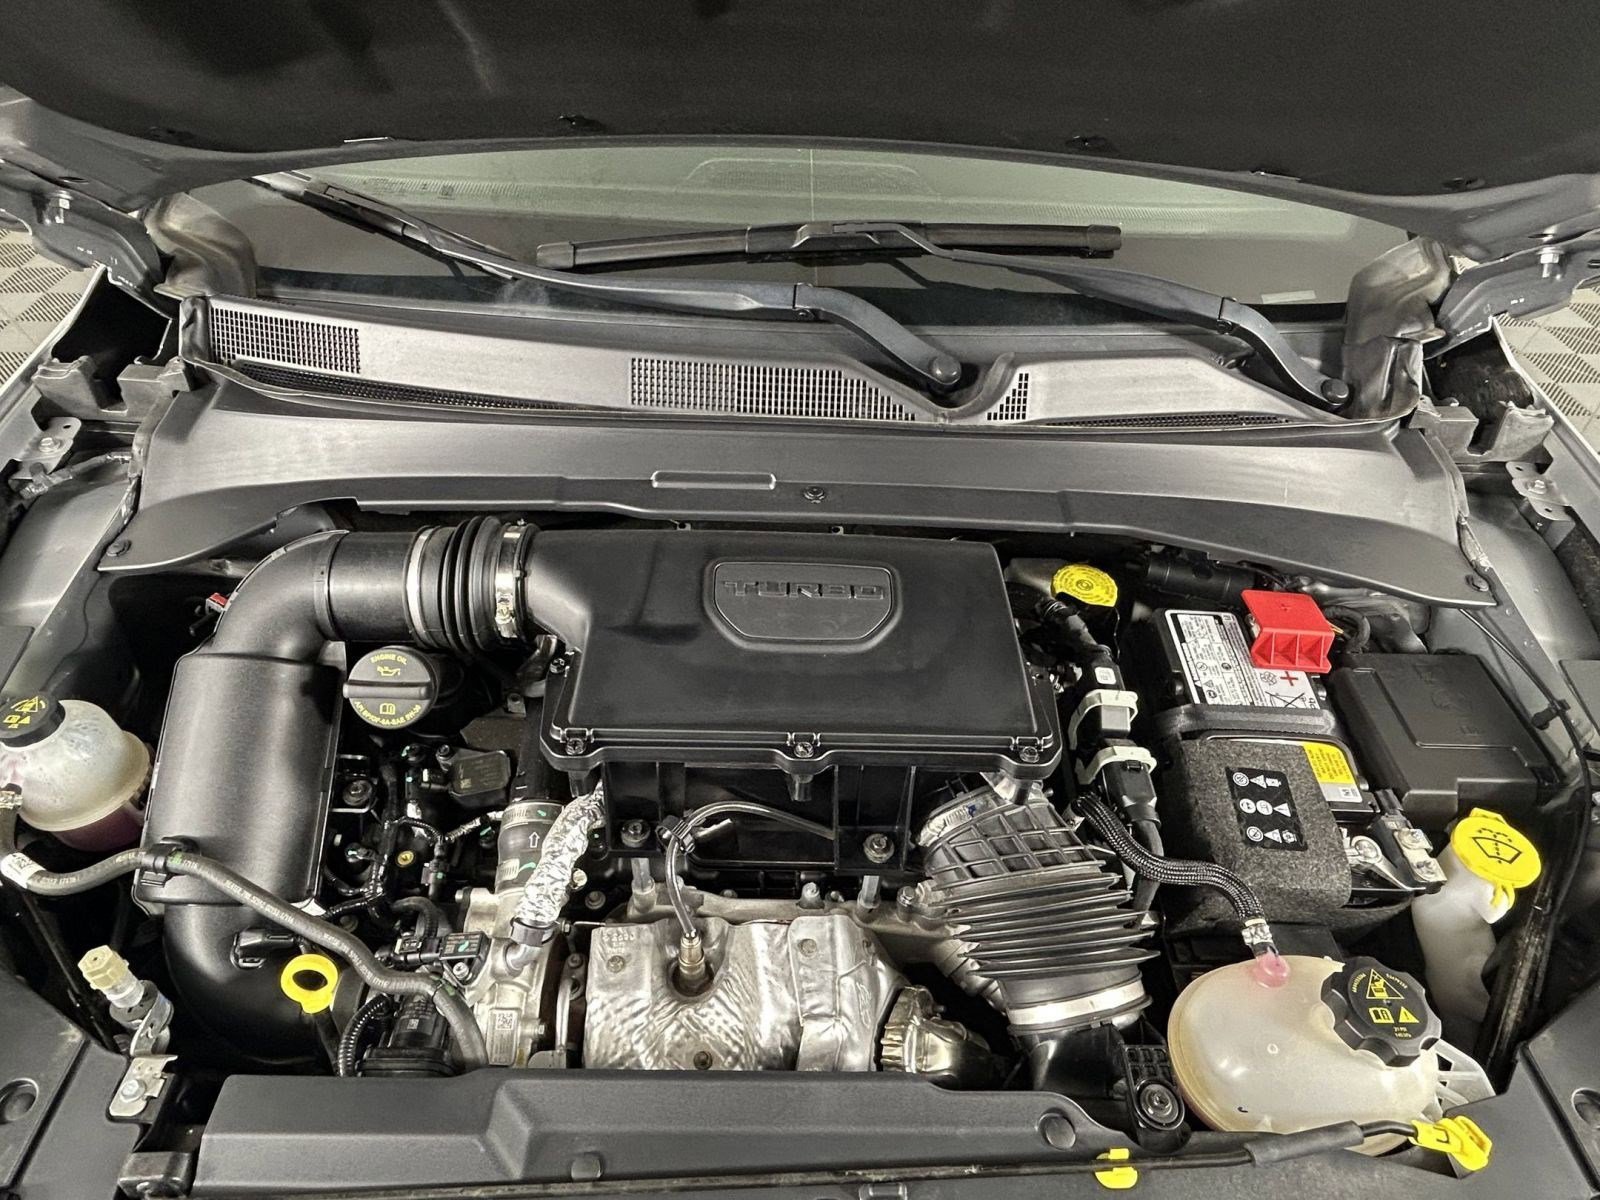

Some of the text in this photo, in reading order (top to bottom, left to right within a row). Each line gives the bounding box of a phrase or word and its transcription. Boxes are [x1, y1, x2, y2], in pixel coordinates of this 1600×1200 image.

[723, 580, 885, 600] TURBO
[370, 654, 407, 665] ENGINE OIL
